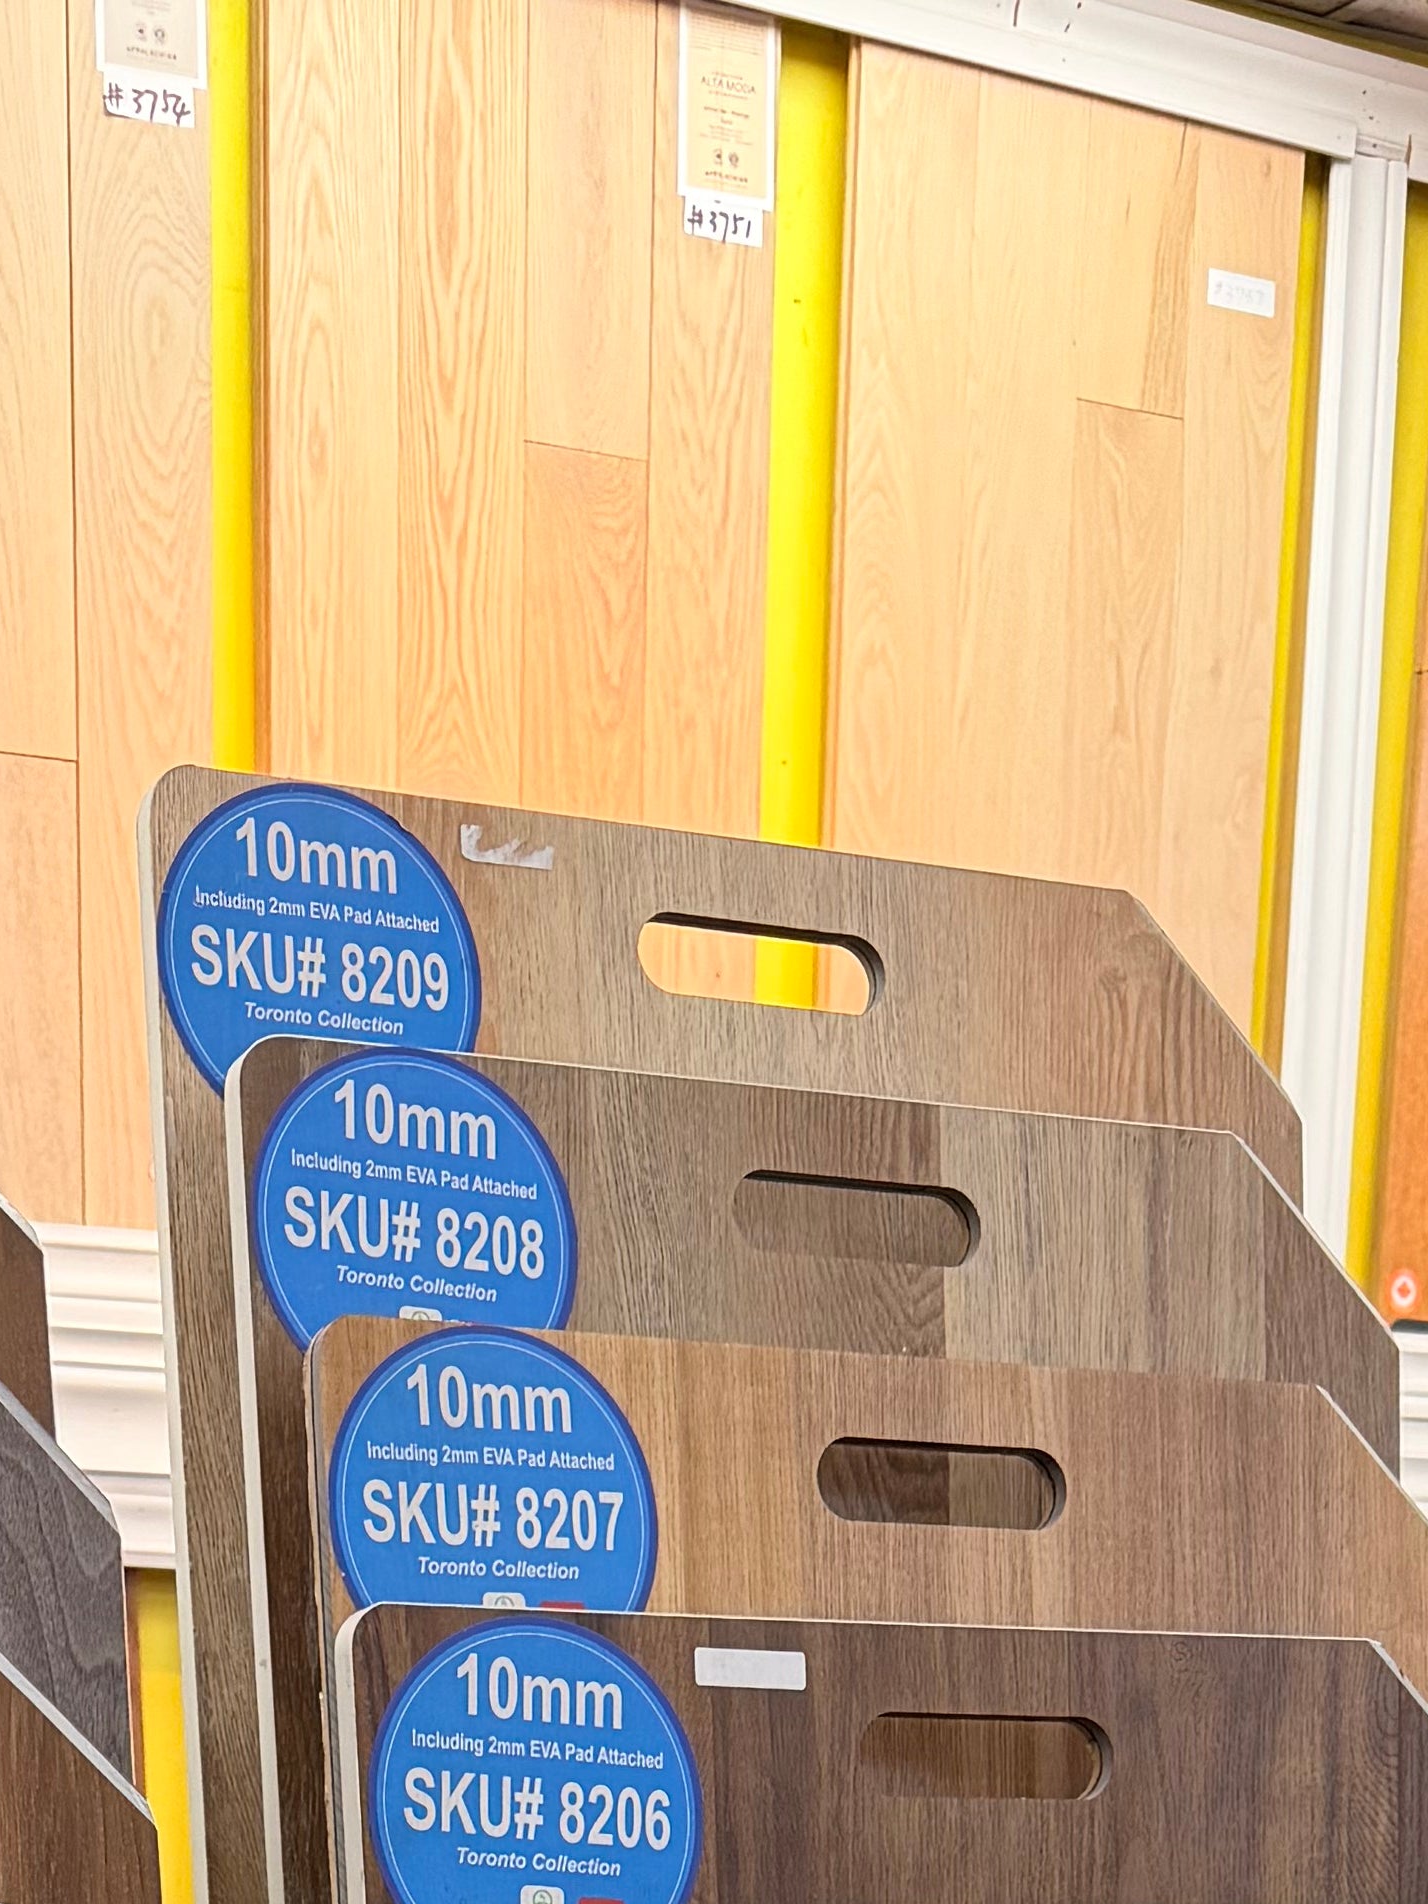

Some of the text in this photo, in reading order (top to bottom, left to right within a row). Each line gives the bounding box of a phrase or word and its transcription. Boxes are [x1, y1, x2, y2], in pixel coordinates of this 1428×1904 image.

[236, 817, 397, 894] 10mm
[195, 885, 439, 933] Including 2mm EVA Pad Attached
[191, 924, 449, 1011] SKU# 8209
[244, 1001, 404, 1035] Toronto Collection
[334, 1079, 496, 1160] 10mm
[284, 1185, 545, 1280] SKU# 8208
[407, 1363, 572, 1433] 10mm
[363, 1478, 624, 1551] SKU# 8207
[456, 1652, 623, 1730] 10mm
[403, 1767, 671, 1851] SKU# 8206
